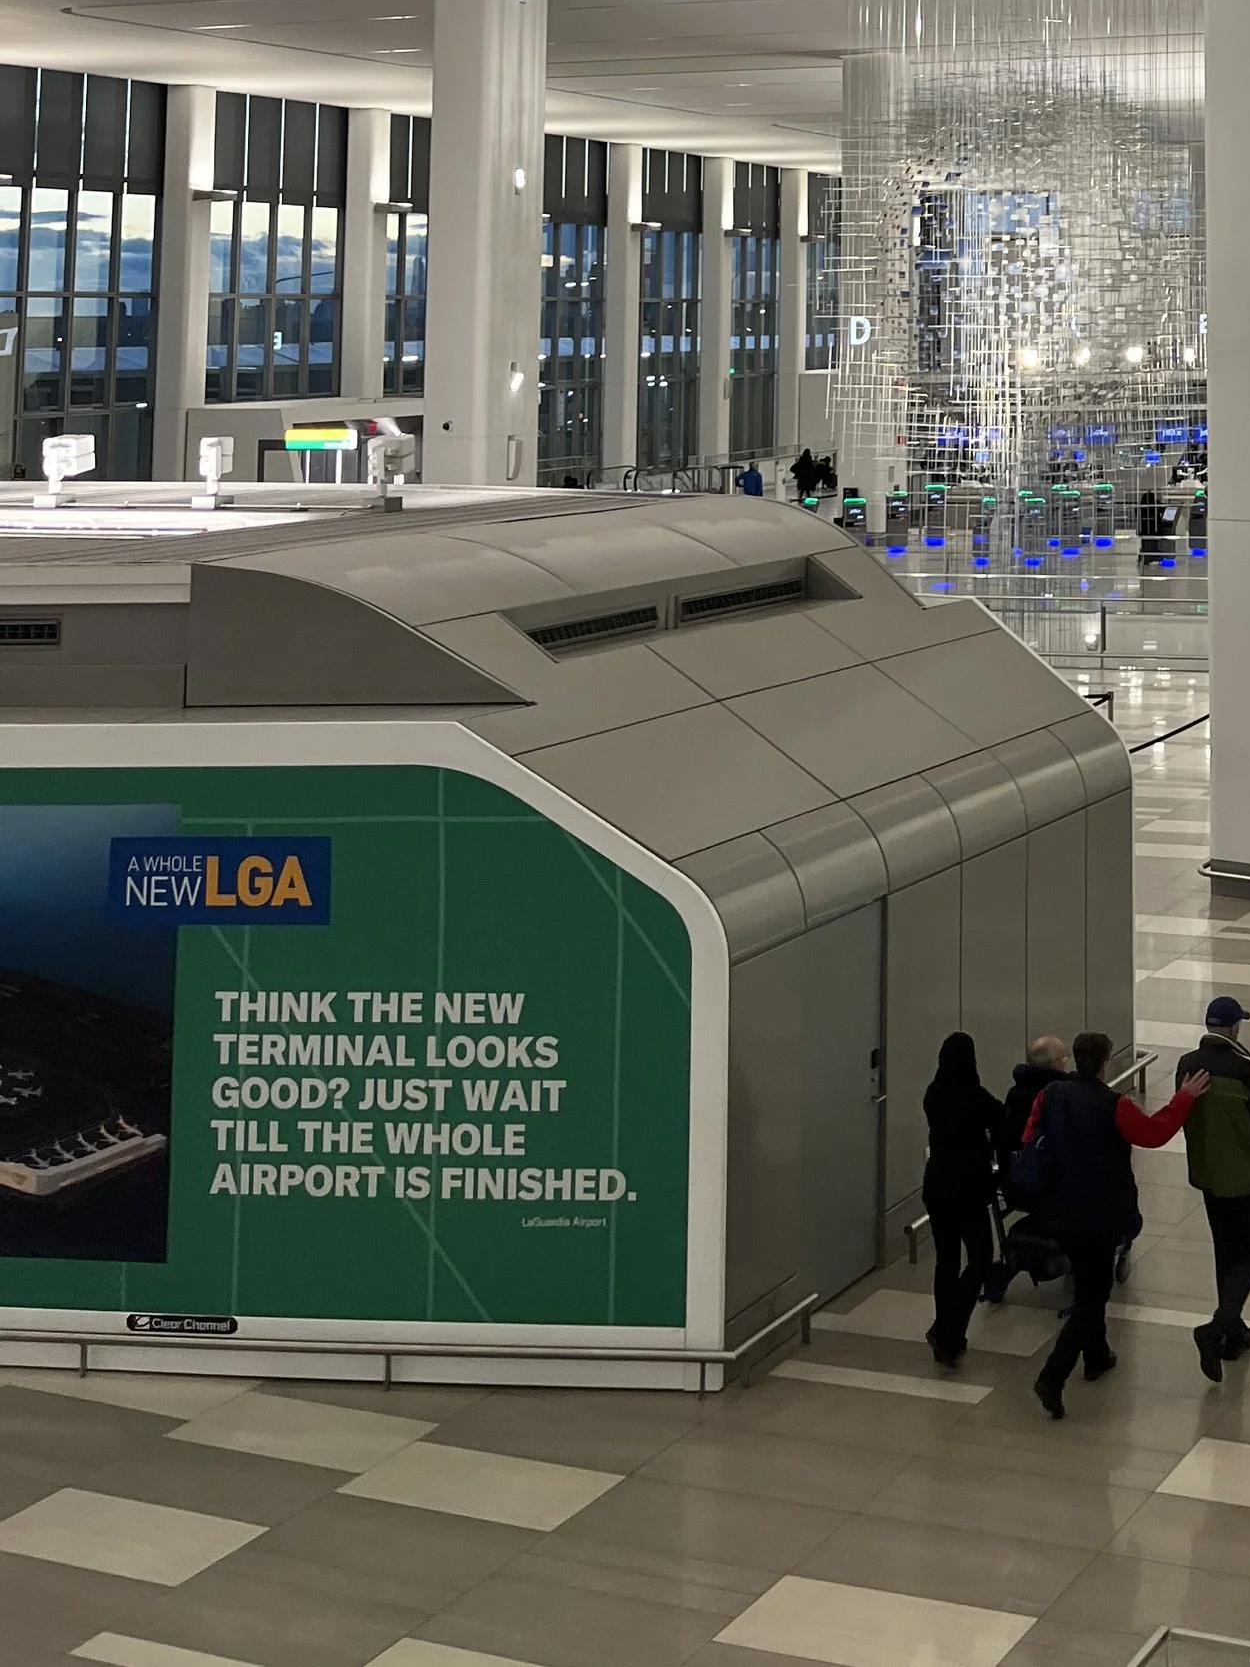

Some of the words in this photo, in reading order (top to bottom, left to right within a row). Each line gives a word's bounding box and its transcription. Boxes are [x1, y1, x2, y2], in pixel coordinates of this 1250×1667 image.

[851, 316, 871, 345] D
[127, 856, 139, 872] A
[143, 856, 203, 872] WHOLE
[126, 876, 202, 906] NEW
[205, 855, 312, 907] LGA
[215, 991, 337, 1023] THINK
[347, 992, 423, 1023] THE
[434, 992, 525, 1024] NEW
[213, 1034, 415, 1067] TERMINAL
[427, 1035, 559, 1068] LOOKS
[212, 1076, 350, 1109] GOOD?
[358, 1078, 453, 1111] JUST
[462, 1080, 567, 1112] WAIT
[210, 1120, 288, 1152] TILL
[297, 1121, 373, 1153] THE
[385, 1122, 526, 1156] WHOLE
[209, 1163, 385, 1198] AIRPORT
[395, 1166, 431, 1199] IS
[441, 1167, 637, 1201] FINISHED.
[573, 1216, 606, 1228] Airport
[152, 1318, 181, 1329] Clear
[183, 1319, 231, 1331] Channel
